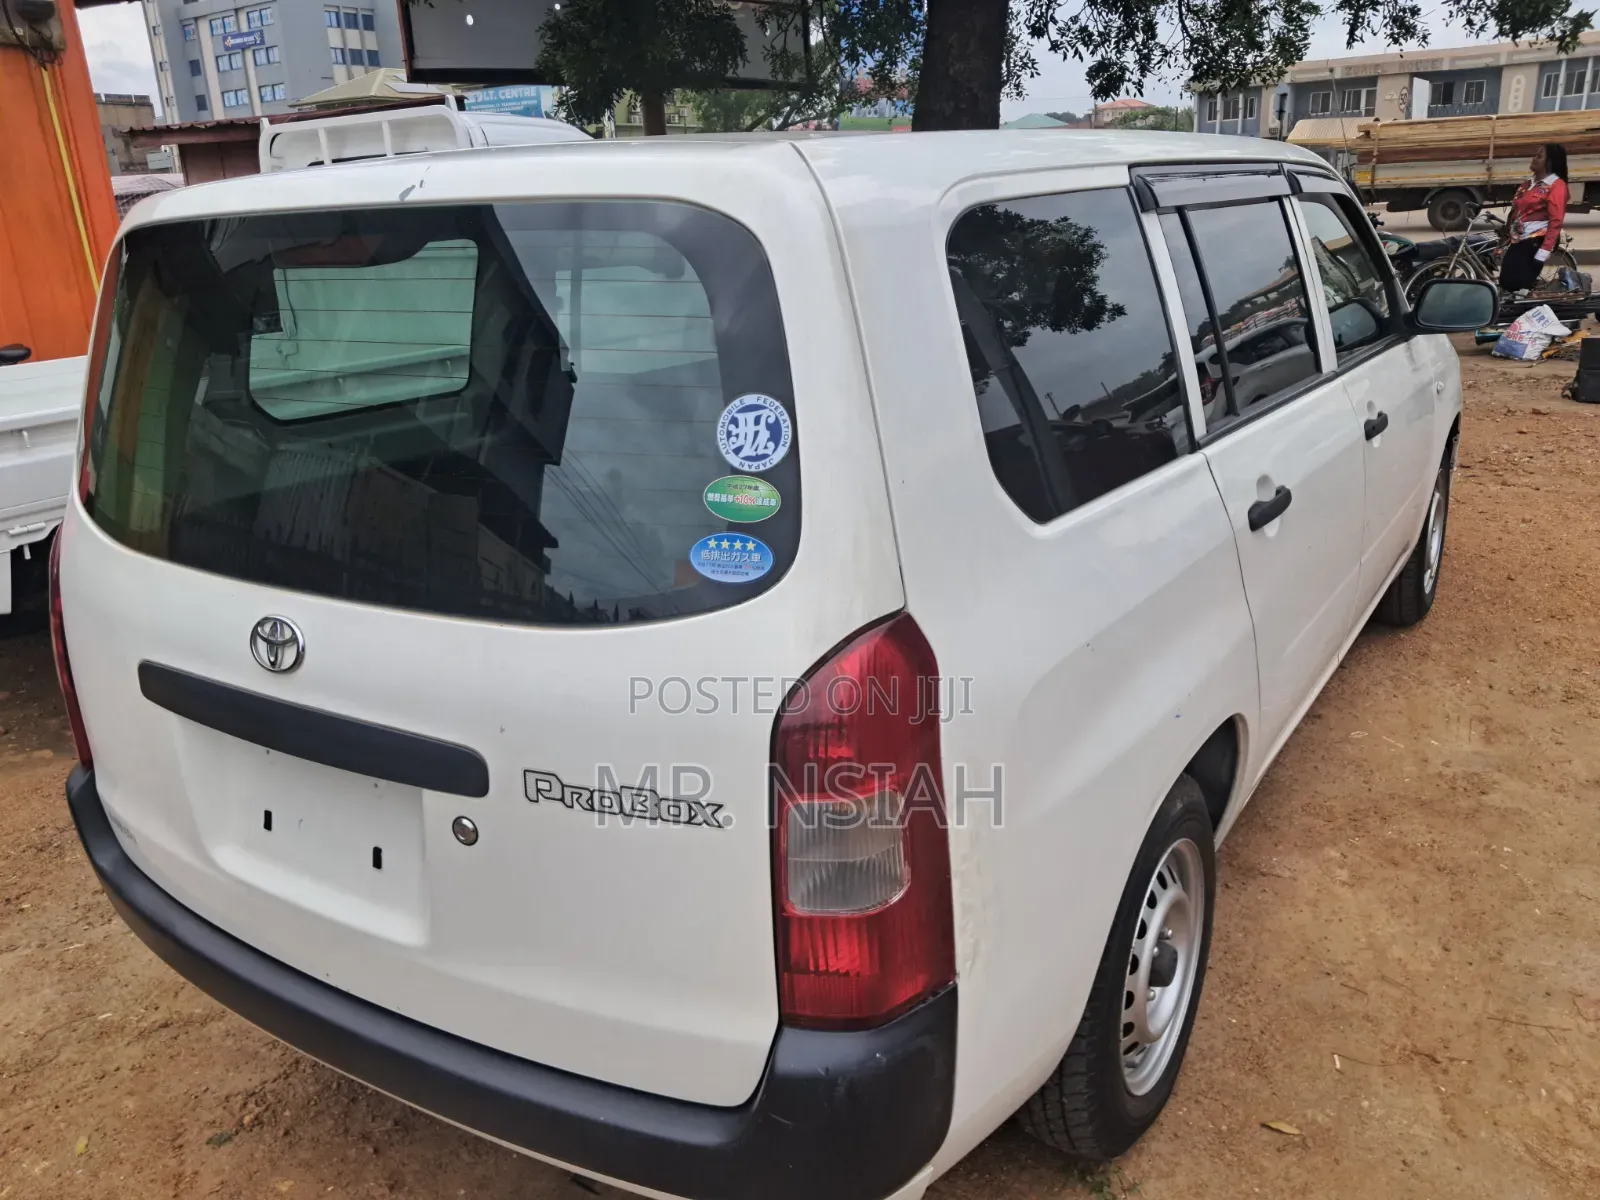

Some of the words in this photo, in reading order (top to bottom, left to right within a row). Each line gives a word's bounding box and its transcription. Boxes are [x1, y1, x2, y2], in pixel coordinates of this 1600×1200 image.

[499, 87, 537, 99] CENTRE
[719, 398, 745, 455] AUTOMOBILE
[756, 396, 790, 447] FEDERATION
[738, 457, 774, 470] JAPAN
[701, 549, 762, 563] 低排出ガス車
